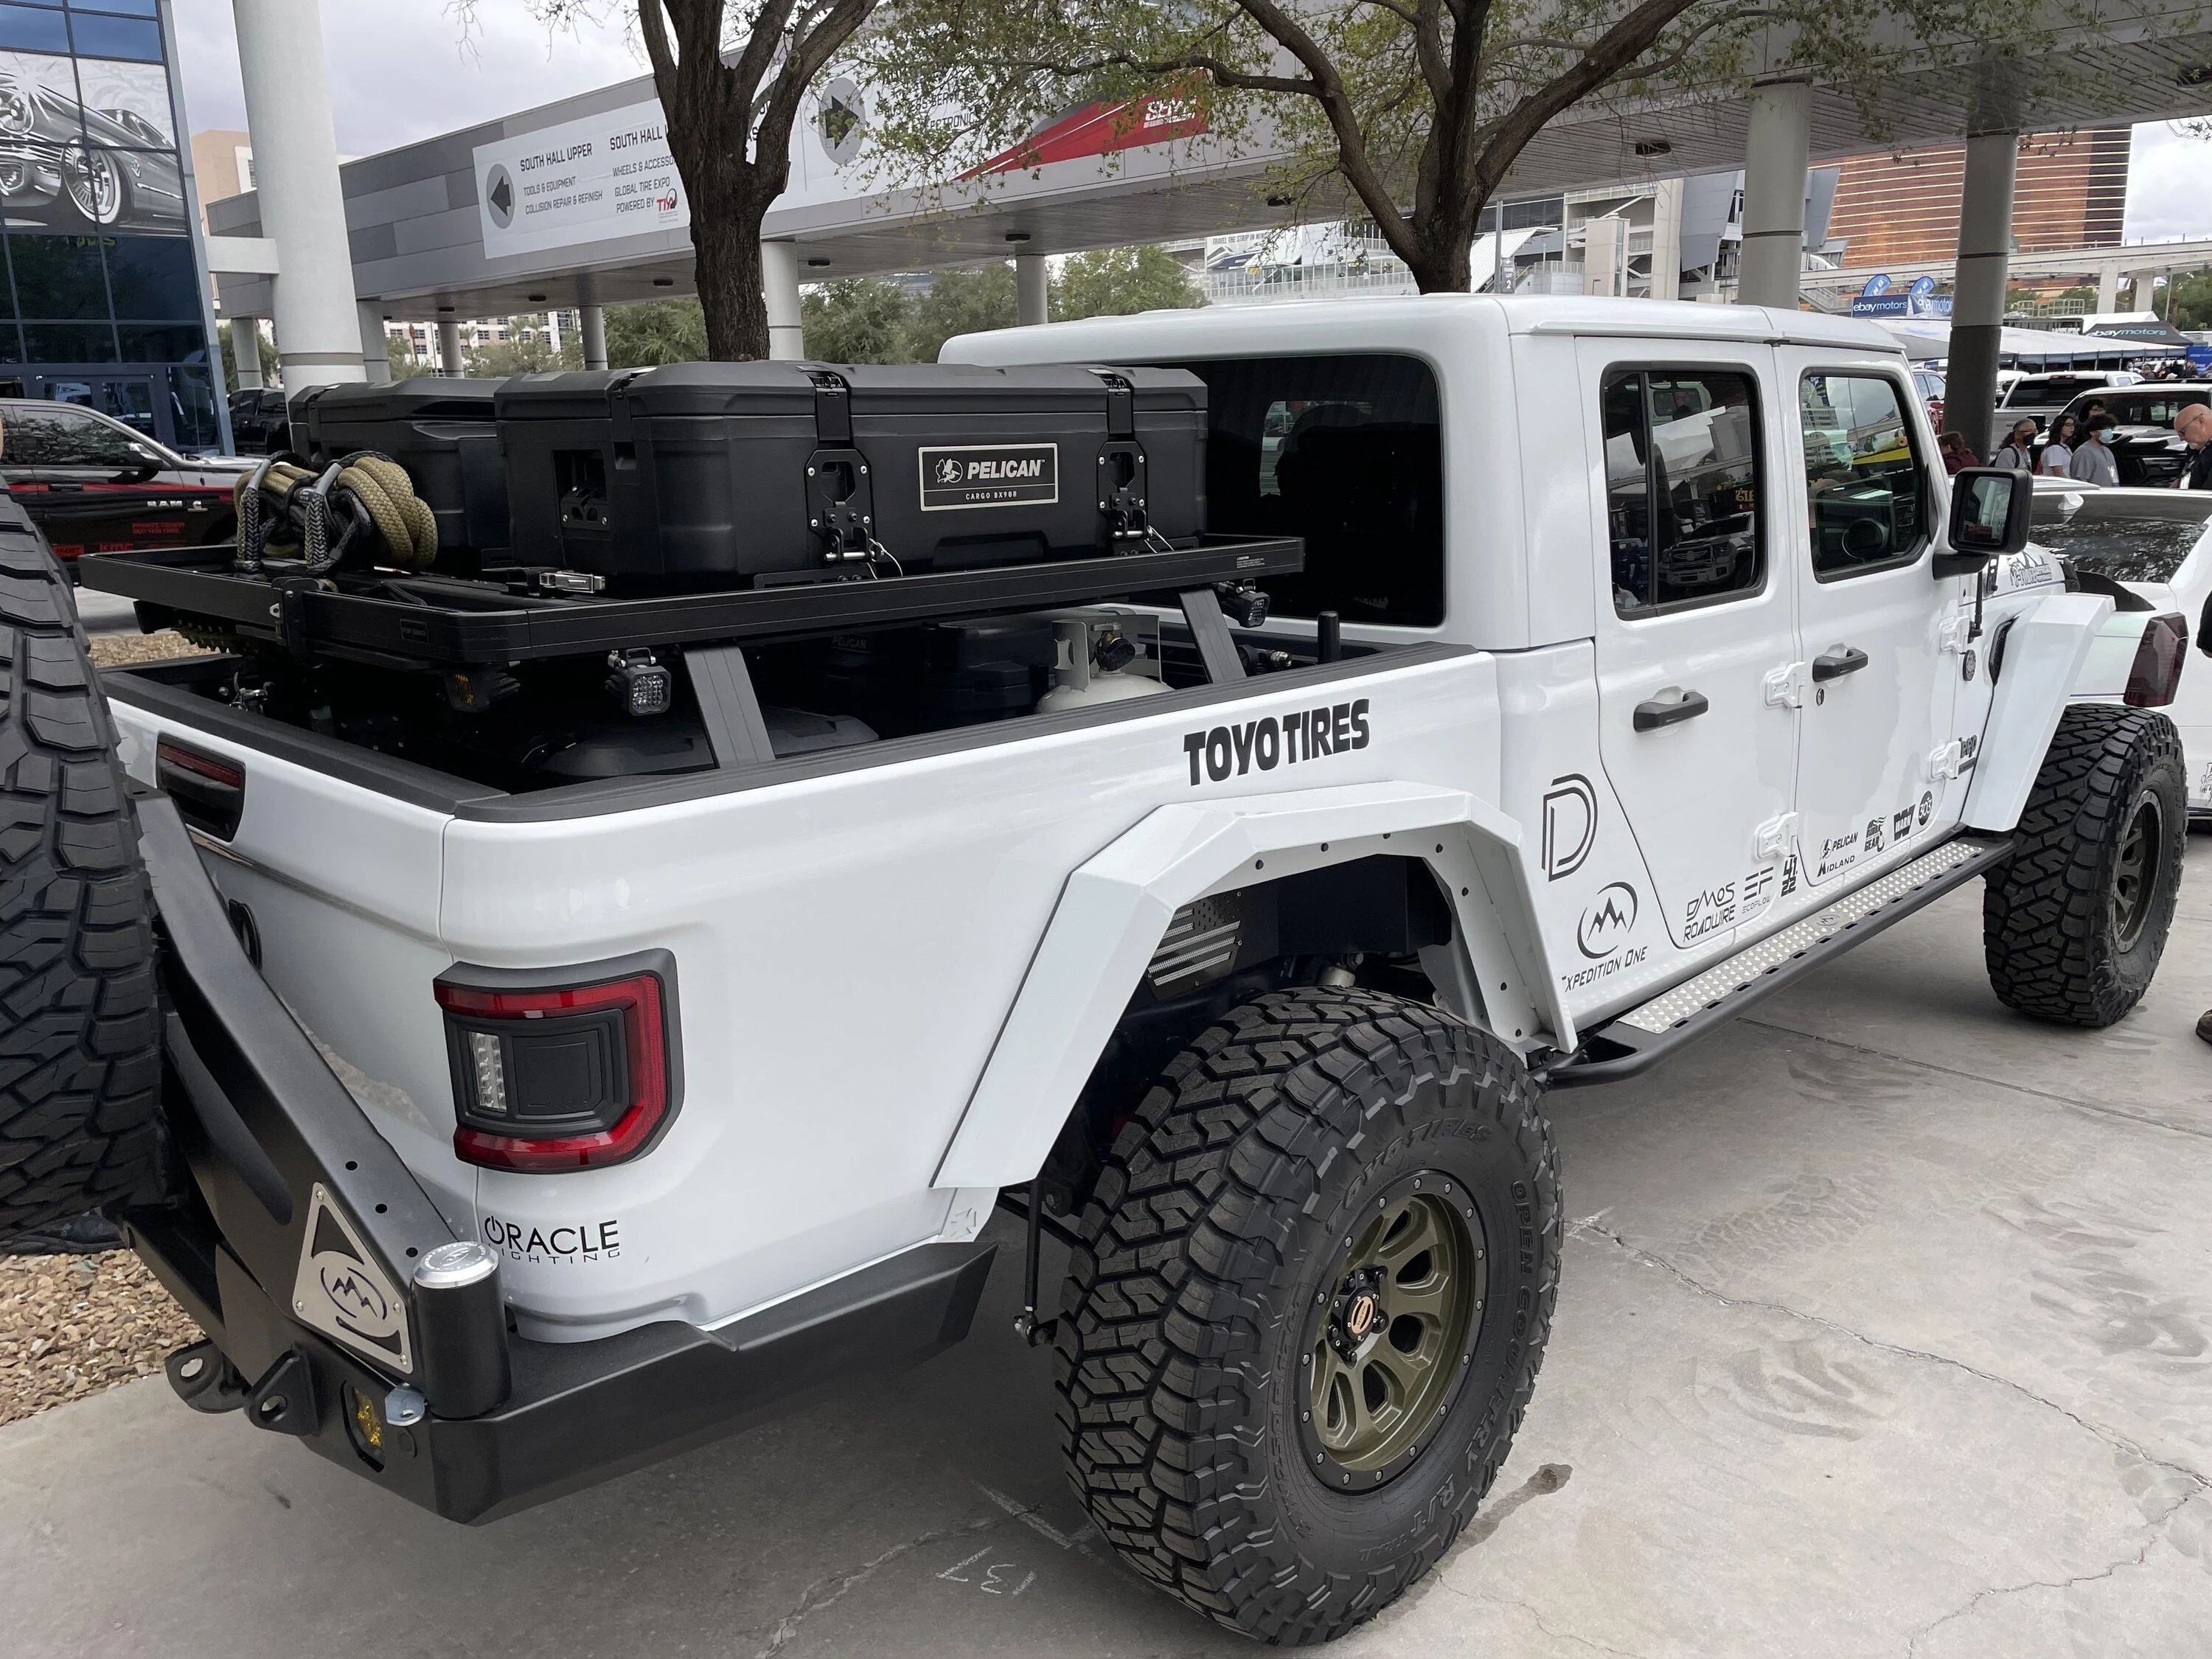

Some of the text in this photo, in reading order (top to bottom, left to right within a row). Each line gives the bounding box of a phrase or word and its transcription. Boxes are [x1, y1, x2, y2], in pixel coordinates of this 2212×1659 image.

[610, 131, 638, 150] SOUTH
[640, 126, 662, 143] HALL
[521, 143, 592, 172] SOUTH HALL UPPER
[613, 155, 675, 177] WHEELS & ACCESSO
[524, 176, 576, 196] TOOLS & EQUIPMENT
[615, 176, 670, 197] GLOBAL TIRE EXPO
[525, 189, 603, 215] COLLISION REPAIR & REFINISH
[616, 198, 645, 213] POWERED
[647, 197, 655, 208] BY
[1212, 237, 1227, 245] TRAVEL
[1237, 234, 1250, 243] STRIP
[1506, 279, 1512, 289] 2
[967, 459, 1041, 479] PELICAN
[147, 500, 183, 508] RAM
[965, 490, 1017, 500] CARGO BX90R
[1919, 797, 1933, 818] 303
[1895, 813, 1912, 833] WARN
[1832, 831, 1858, 852] PELICAN
[1817, 855, 1855, 878] MIDLAND
[1743, 866, 1774, 902] EF
[1742, 894, 1771, 914] ECOFLOW
[1683, 903, 1736, 942] ROADWIRE
[484, 1215, 620, 1255] ORACLE
[488, 1242, 620, 1265] IGHTING
[1465, 1180, 1534, 1473] OPEN COUNTRY
